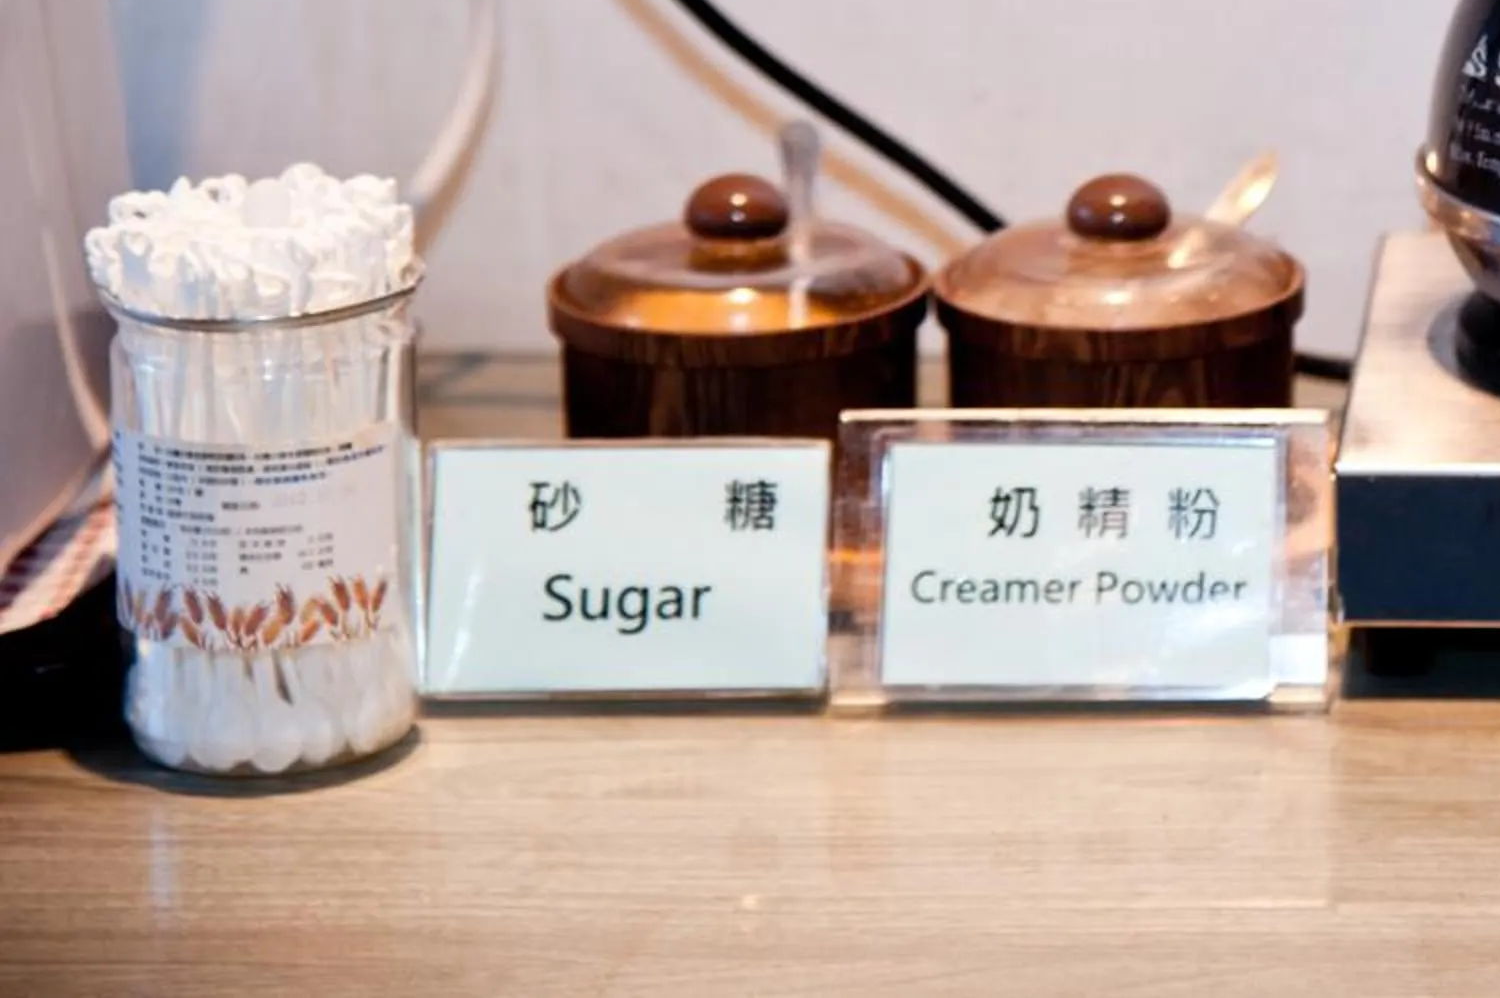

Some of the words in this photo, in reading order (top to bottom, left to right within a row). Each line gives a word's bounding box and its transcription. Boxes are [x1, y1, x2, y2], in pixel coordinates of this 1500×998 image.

[543, 573, 712, 635] Sugar
[910, 569, 1082, 604] Creamer
[1095, 571, 1248, 604] Powder
